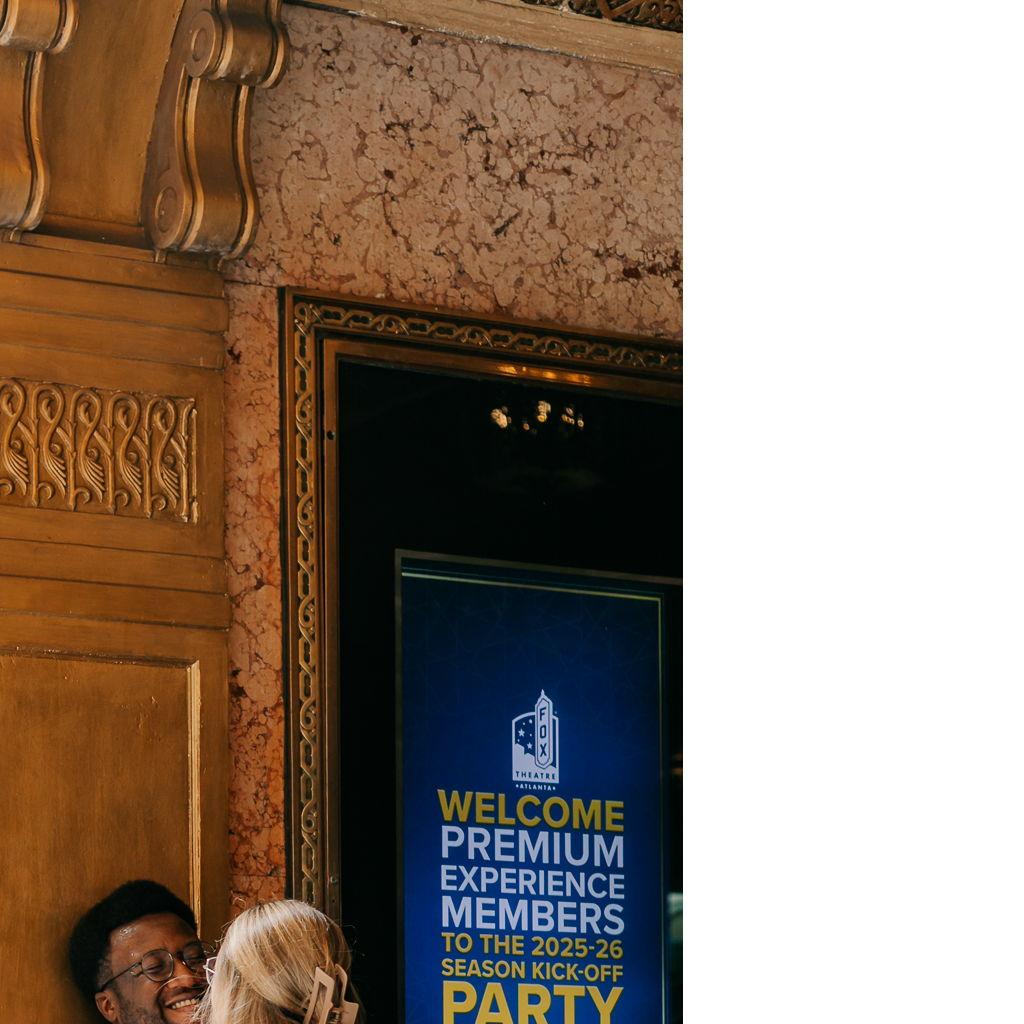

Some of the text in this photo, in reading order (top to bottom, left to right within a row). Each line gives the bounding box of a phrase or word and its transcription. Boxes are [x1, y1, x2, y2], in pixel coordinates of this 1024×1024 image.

[539, 707, 547, 757] FOX
[515, 770, 556, 780] THEATRE
[437, 789, 624, 832] WELCOME
[441, 825, 624, 868] PREMIUM
[440, 865, 625, 900] EXPERIENCE
[442, 895, 625, 936] MEMBERS
[441, 932, 623, 959] TO THE 2025-26
[441, 958, 624, 982] SEASON KICK-OFF
